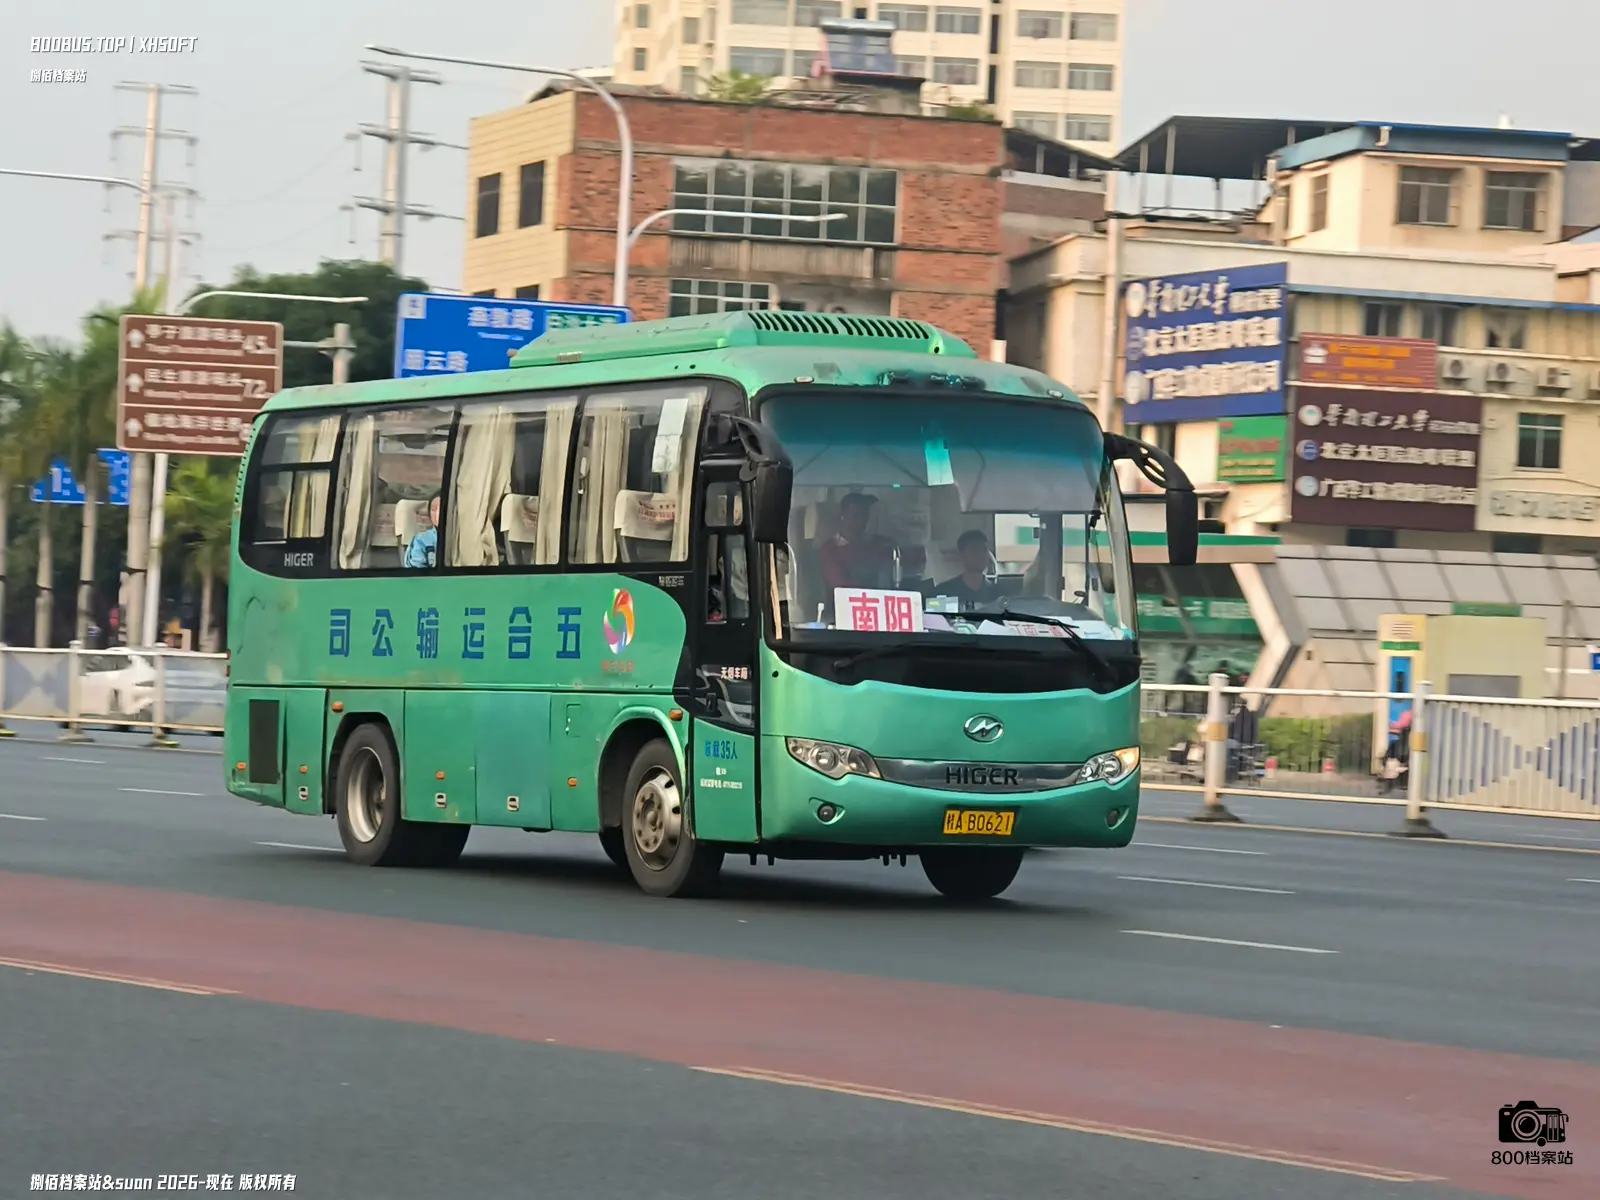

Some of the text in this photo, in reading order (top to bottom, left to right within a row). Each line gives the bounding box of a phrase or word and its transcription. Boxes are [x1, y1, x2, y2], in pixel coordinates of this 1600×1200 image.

[284, 552, 314, 568] HIGER
[848, 592, 914, 633] 南阳
[946, 766, 1019, 785] HIGER
